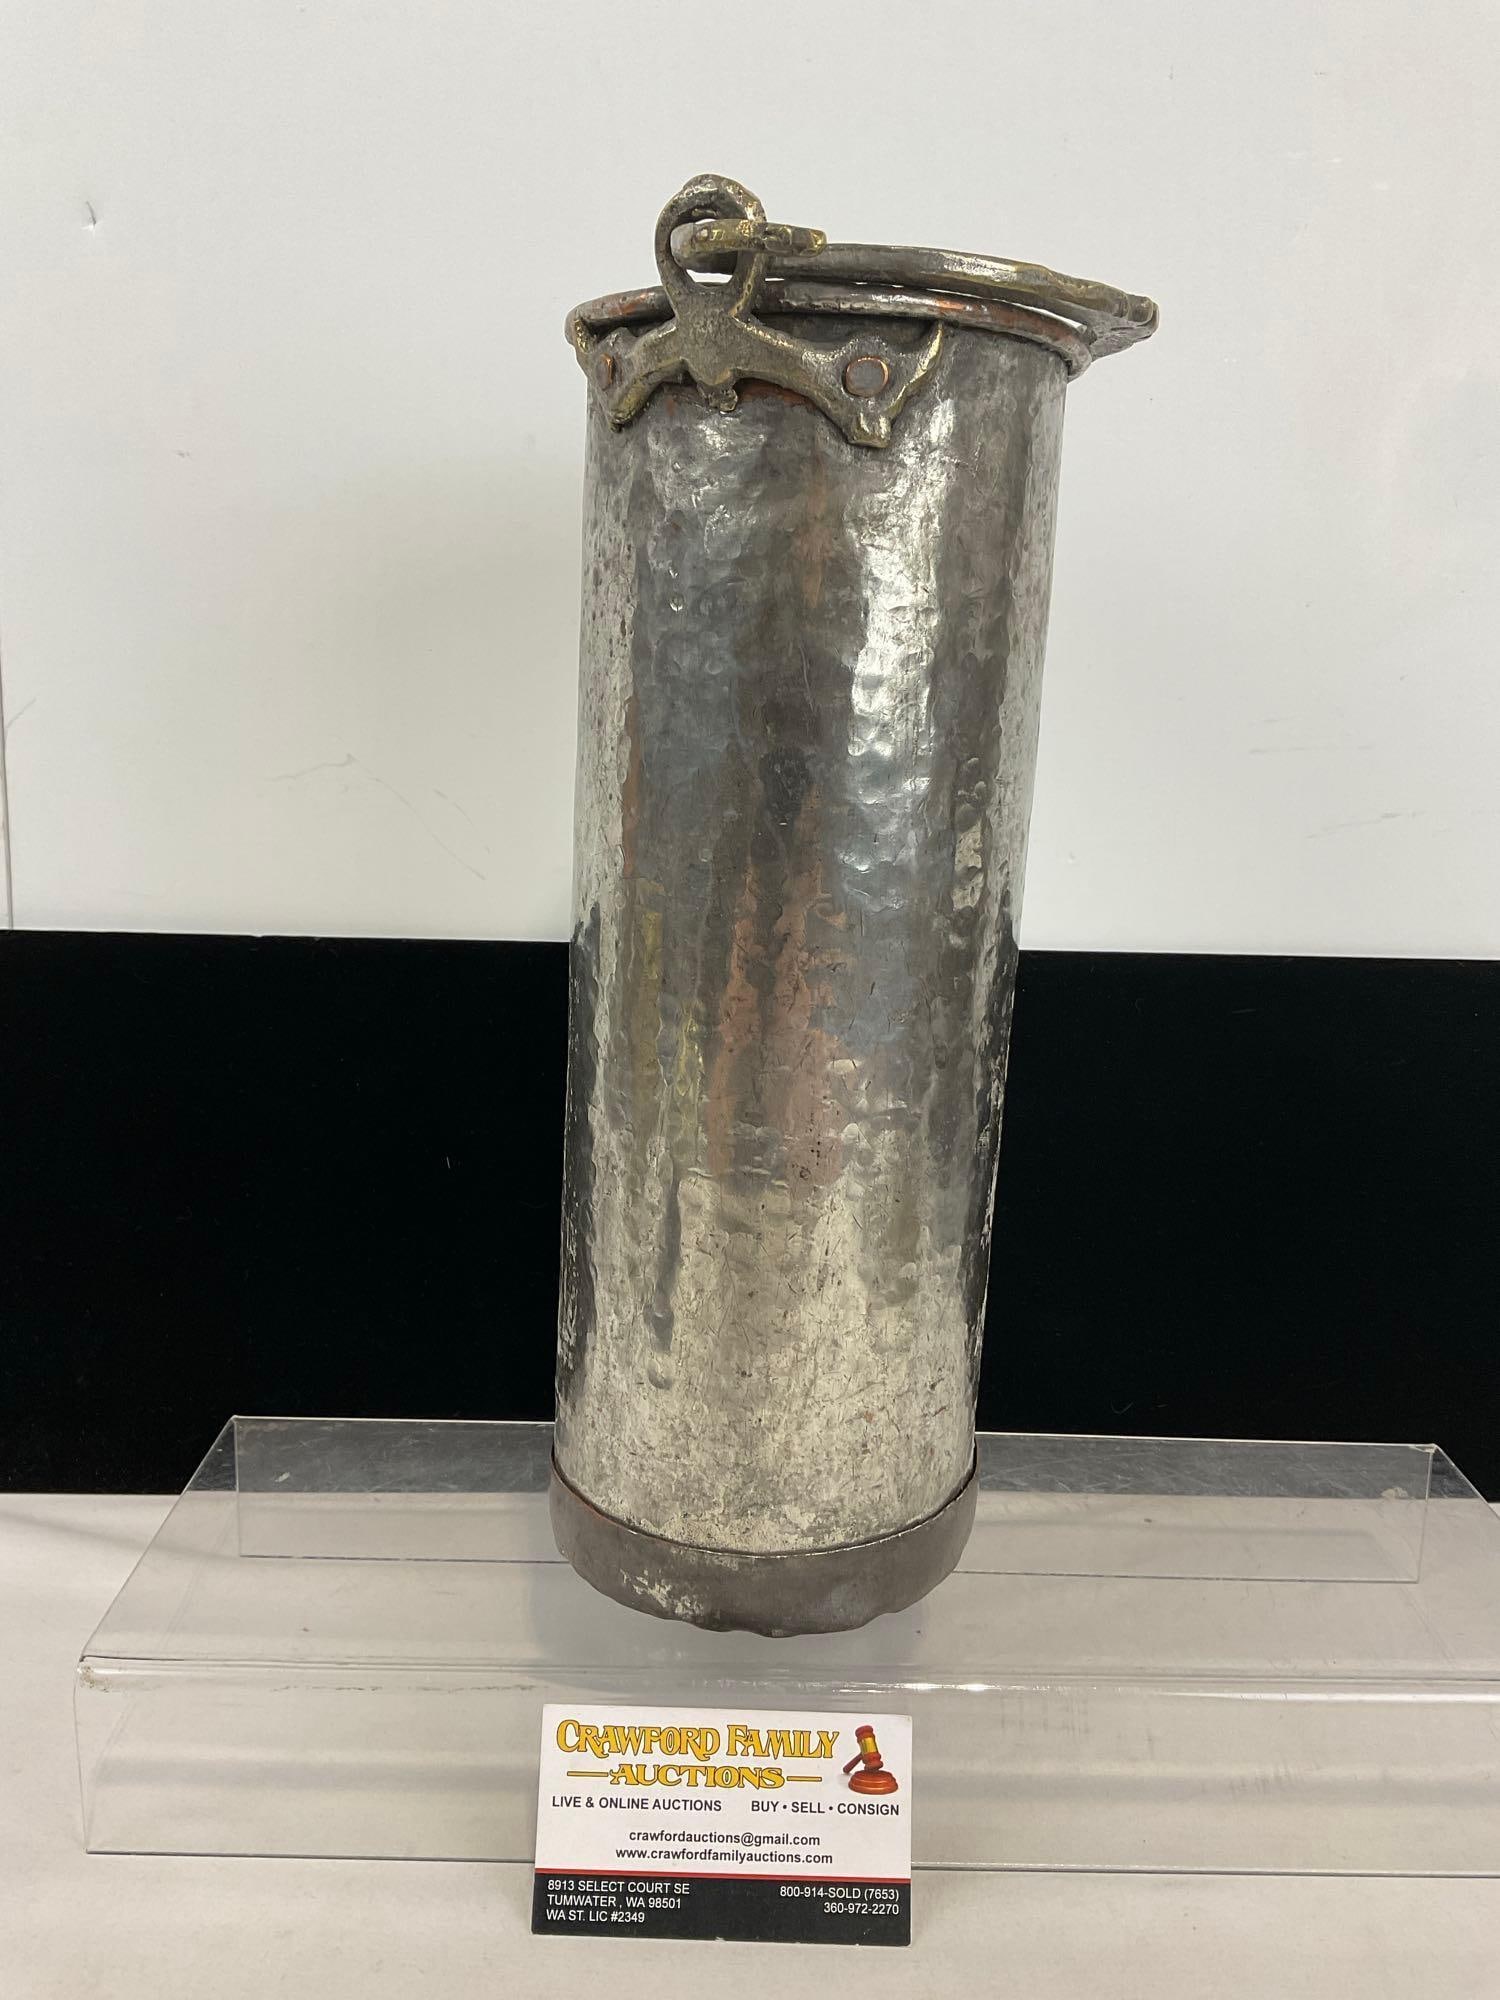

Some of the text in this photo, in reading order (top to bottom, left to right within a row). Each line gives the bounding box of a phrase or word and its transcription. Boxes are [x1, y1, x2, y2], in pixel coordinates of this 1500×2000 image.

[556, 1719, 840, 1760] CRAWFORD FAMILY
[609, 1764, 786, 1790] AUCTIONS
[552, 1796, 722, 1811] LIVE & ONLINE AUCTIONS
[751, 1800, 900, 1815] BUY SELL CONSIGN
[629, 1830, 820, 1847] crawfordauctions@gmail.com
[616, 1847, 833, 1865] www.crawfordfamilyauctions.com
[548, 1880, 689, 1894] 8913 SELECT COURT SE
[780, 1886, 899, 1901] 800-914-SOLD (7653)
[625, 1897, 645, 1908] WA
[648, 1898, 681, 1909] 98501
[824, 1903, 899, 1915] 360-972-2270
[546, 1910, 645, 1923] WA ST. LIC #2349
